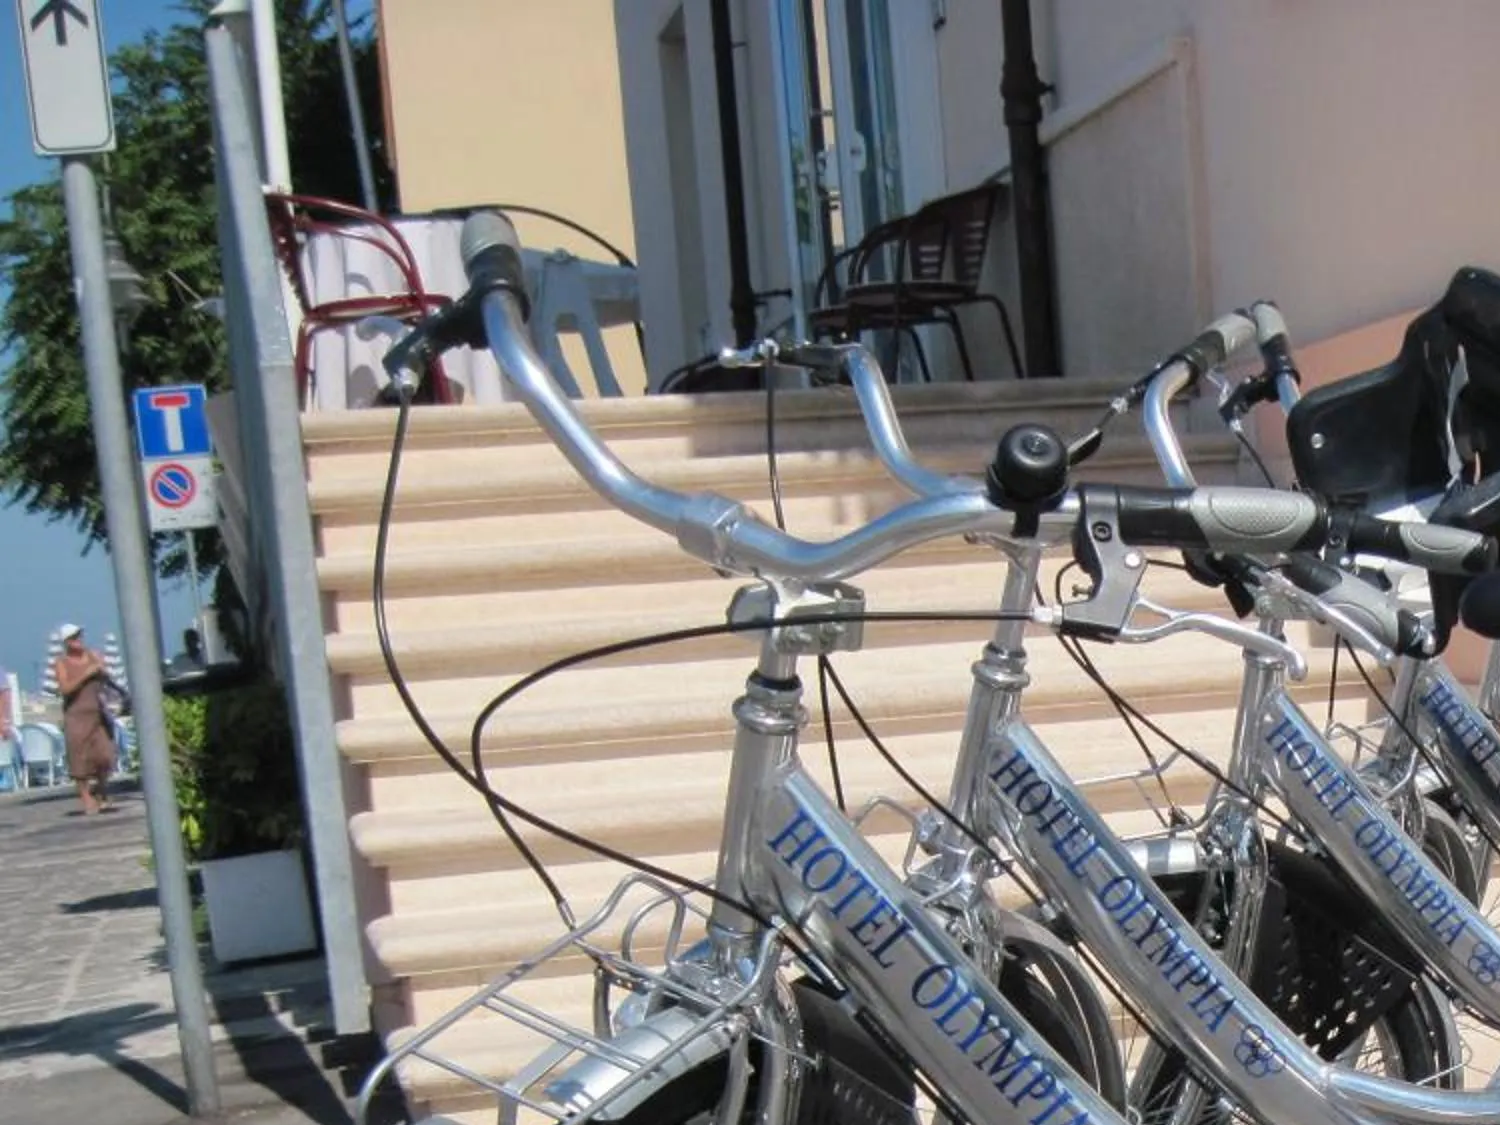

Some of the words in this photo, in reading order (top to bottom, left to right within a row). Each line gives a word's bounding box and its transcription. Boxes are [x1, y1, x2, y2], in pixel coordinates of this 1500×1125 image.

[1420, 681, 1497, 767] HOTEL
[766, 808, 920, 970] HOTEL
[990, 749, 1100, 879] HOTEL
[1100, 874, 1238, 1034] OLYMPIA
[1265, 717, 1360, 822] HOTEL
[1354, 818, 1469, 946] OLYMPIA
